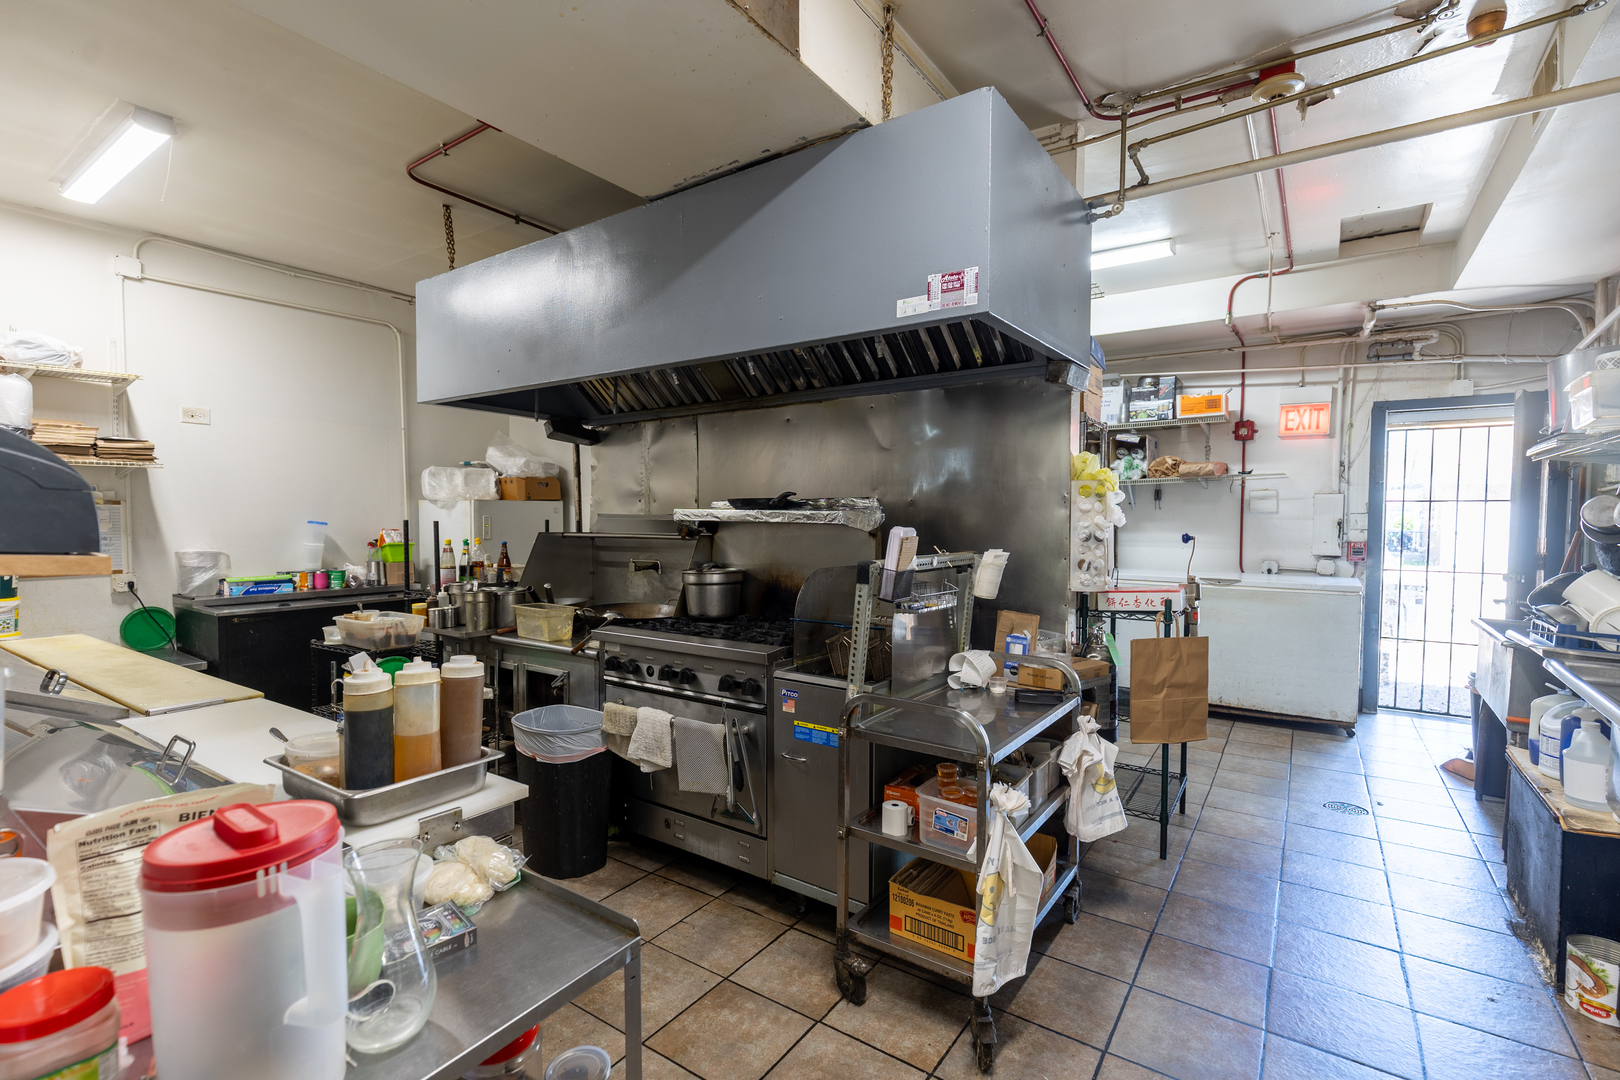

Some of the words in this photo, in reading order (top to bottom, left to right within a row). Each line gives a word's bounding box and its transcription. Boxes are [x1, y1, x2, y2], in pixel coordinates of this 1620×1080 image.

[1284, 407, 1325, 431] EXIT
[78, 831, 126, 848] Nutrition
[129, 824, 158, 836] Facts
[915, 912, 932, 921] PRODUCT
[944, 911, 955, 919] PASTE
[434, 944, 452, 955] CABLE
[1583, 1003, 1607, 1017] Sunlee
